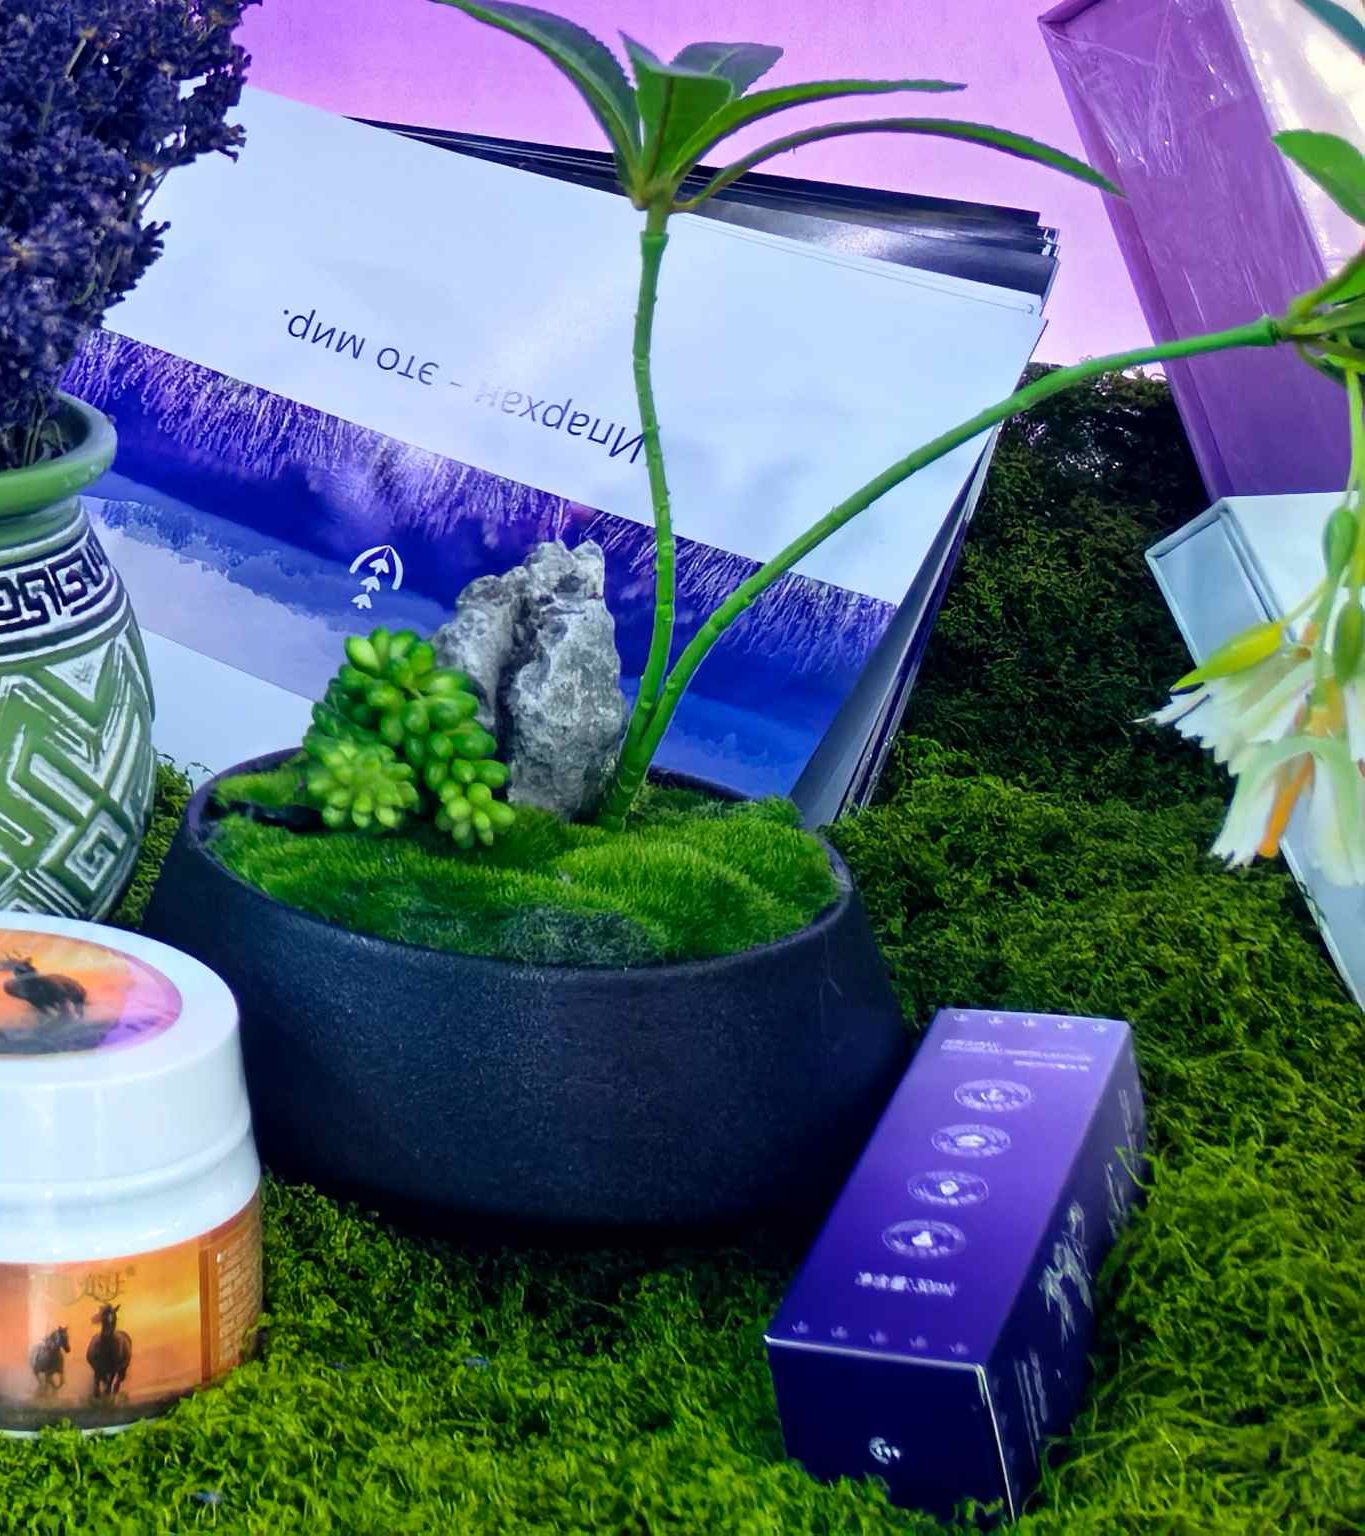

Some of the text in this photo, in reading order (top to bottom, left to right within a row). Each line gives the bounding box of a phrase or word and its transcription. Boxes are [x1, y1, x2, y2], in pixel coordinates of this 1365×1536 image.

[280, 308, 366, 360] мир.
[375, 346, 440, 387] это
[474, 378, 646, 465] Ипархан
